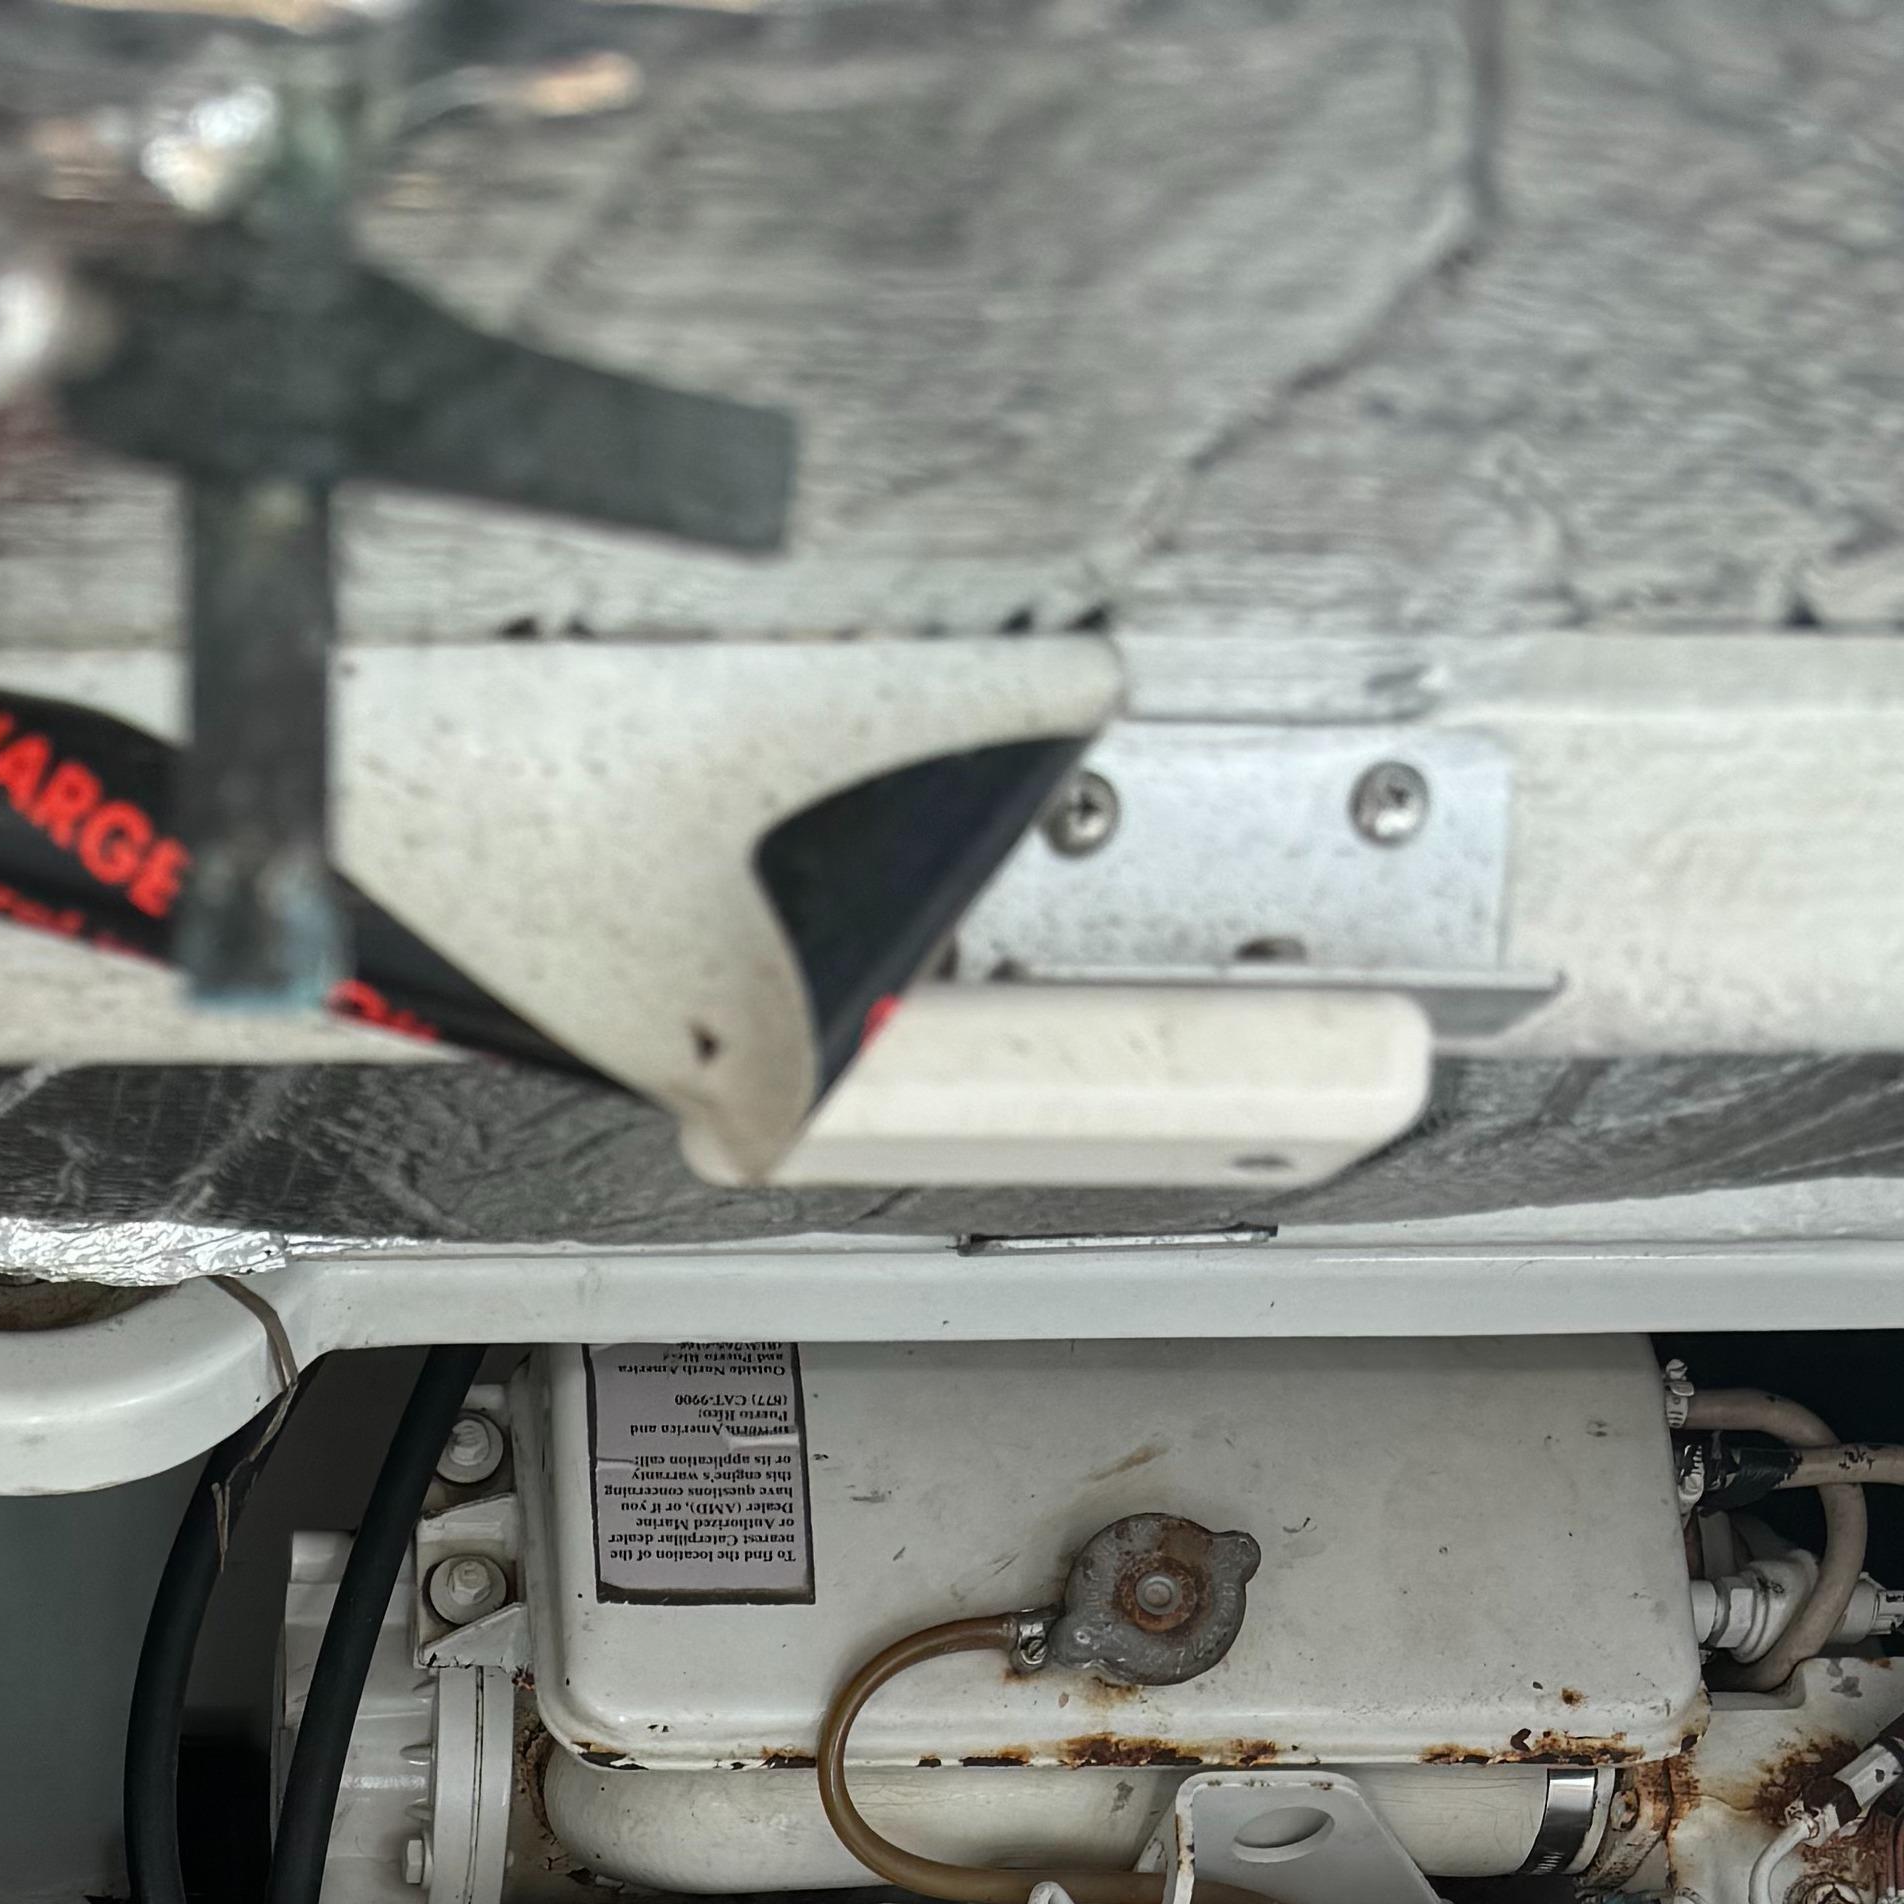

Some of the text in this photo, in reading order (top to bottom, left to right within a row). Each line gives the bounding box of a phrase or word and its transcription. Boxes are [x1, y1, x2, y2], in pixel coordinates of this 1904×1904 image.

[618, 1365, 784, 1375] Outside North America
[752, 1395, 787, 1405] (877)
[740, 1411, 787, 1421] Puerto
[631, 1424, 722, 1436] America and
[635, 1454, 791, 1468] or its application call:
[632, 1469, 791, 1482] this engine's warranty
[604, 1485, 792, 1497] have questions concerning
[621, 1501, 793, 1514] Dealer (AMD), or if you
[636, 1519, 794, 1530] or Authorized Marine
[608, 1532, 794, 1546] nearest Caterpillar dealer
[611, 1551, 795, 1562] To find the location of the
